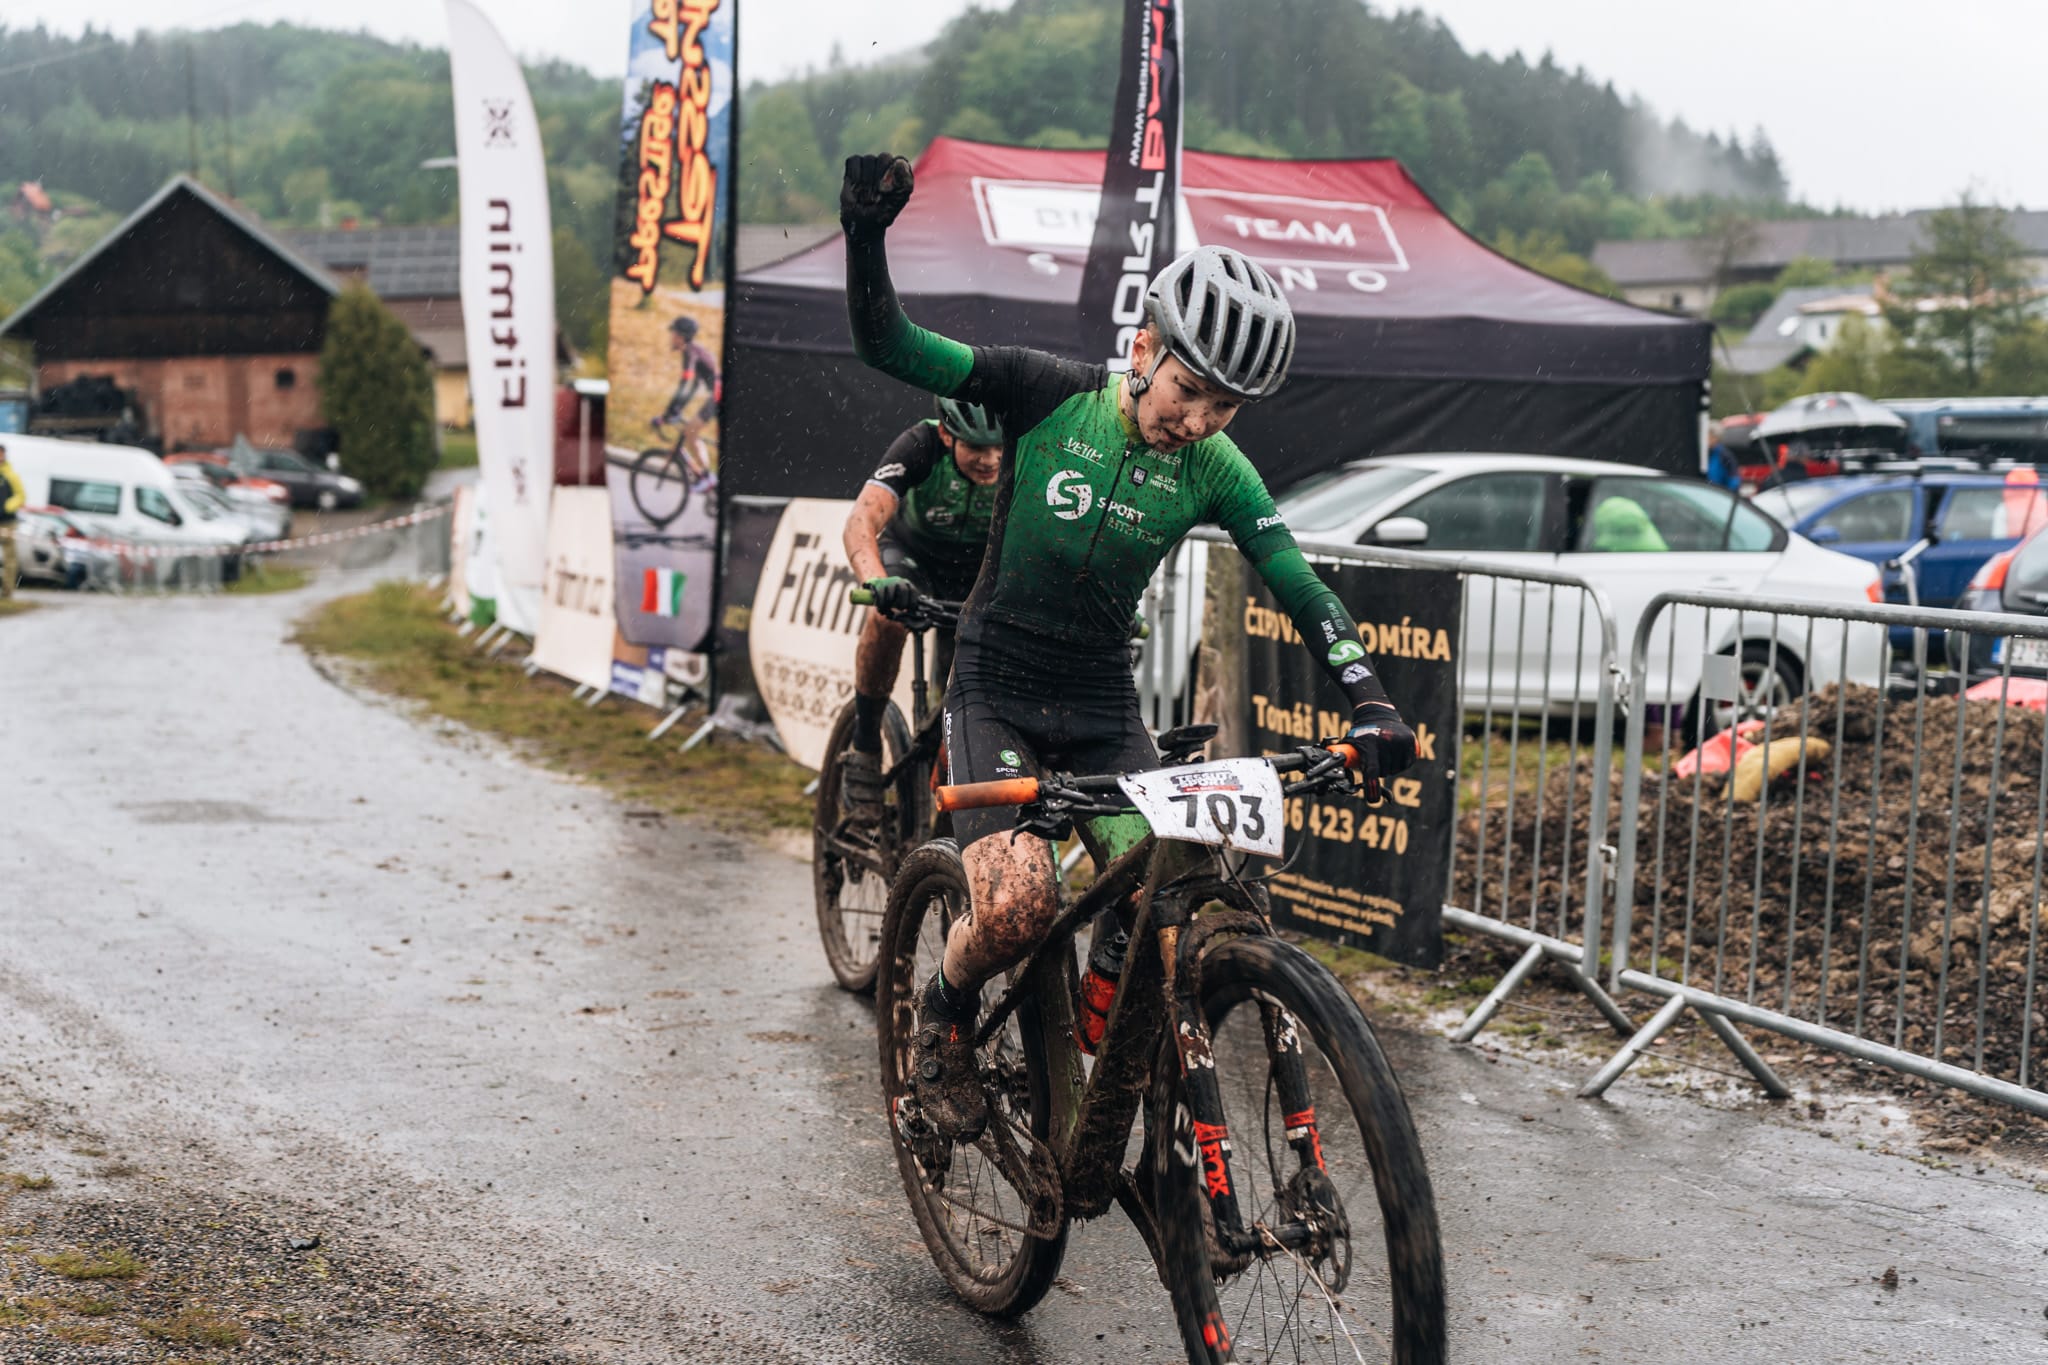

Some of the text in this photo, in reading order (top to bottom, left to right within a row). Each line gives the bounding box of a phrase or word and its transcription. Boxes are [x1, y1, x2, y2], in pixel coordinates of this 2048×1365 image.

[1224, 214, 1356, 247] TEAM
[1096, 497, 1146, 523] SPORT
[1357, 615, 1452, 662] OMÍRA
[1167, 793, 1265, 841] 703
[1308, 803, 1354, 843] 423
[1358, 814, 1409, 855] 470
[1201, 1141, 1231, 1199] FOX
